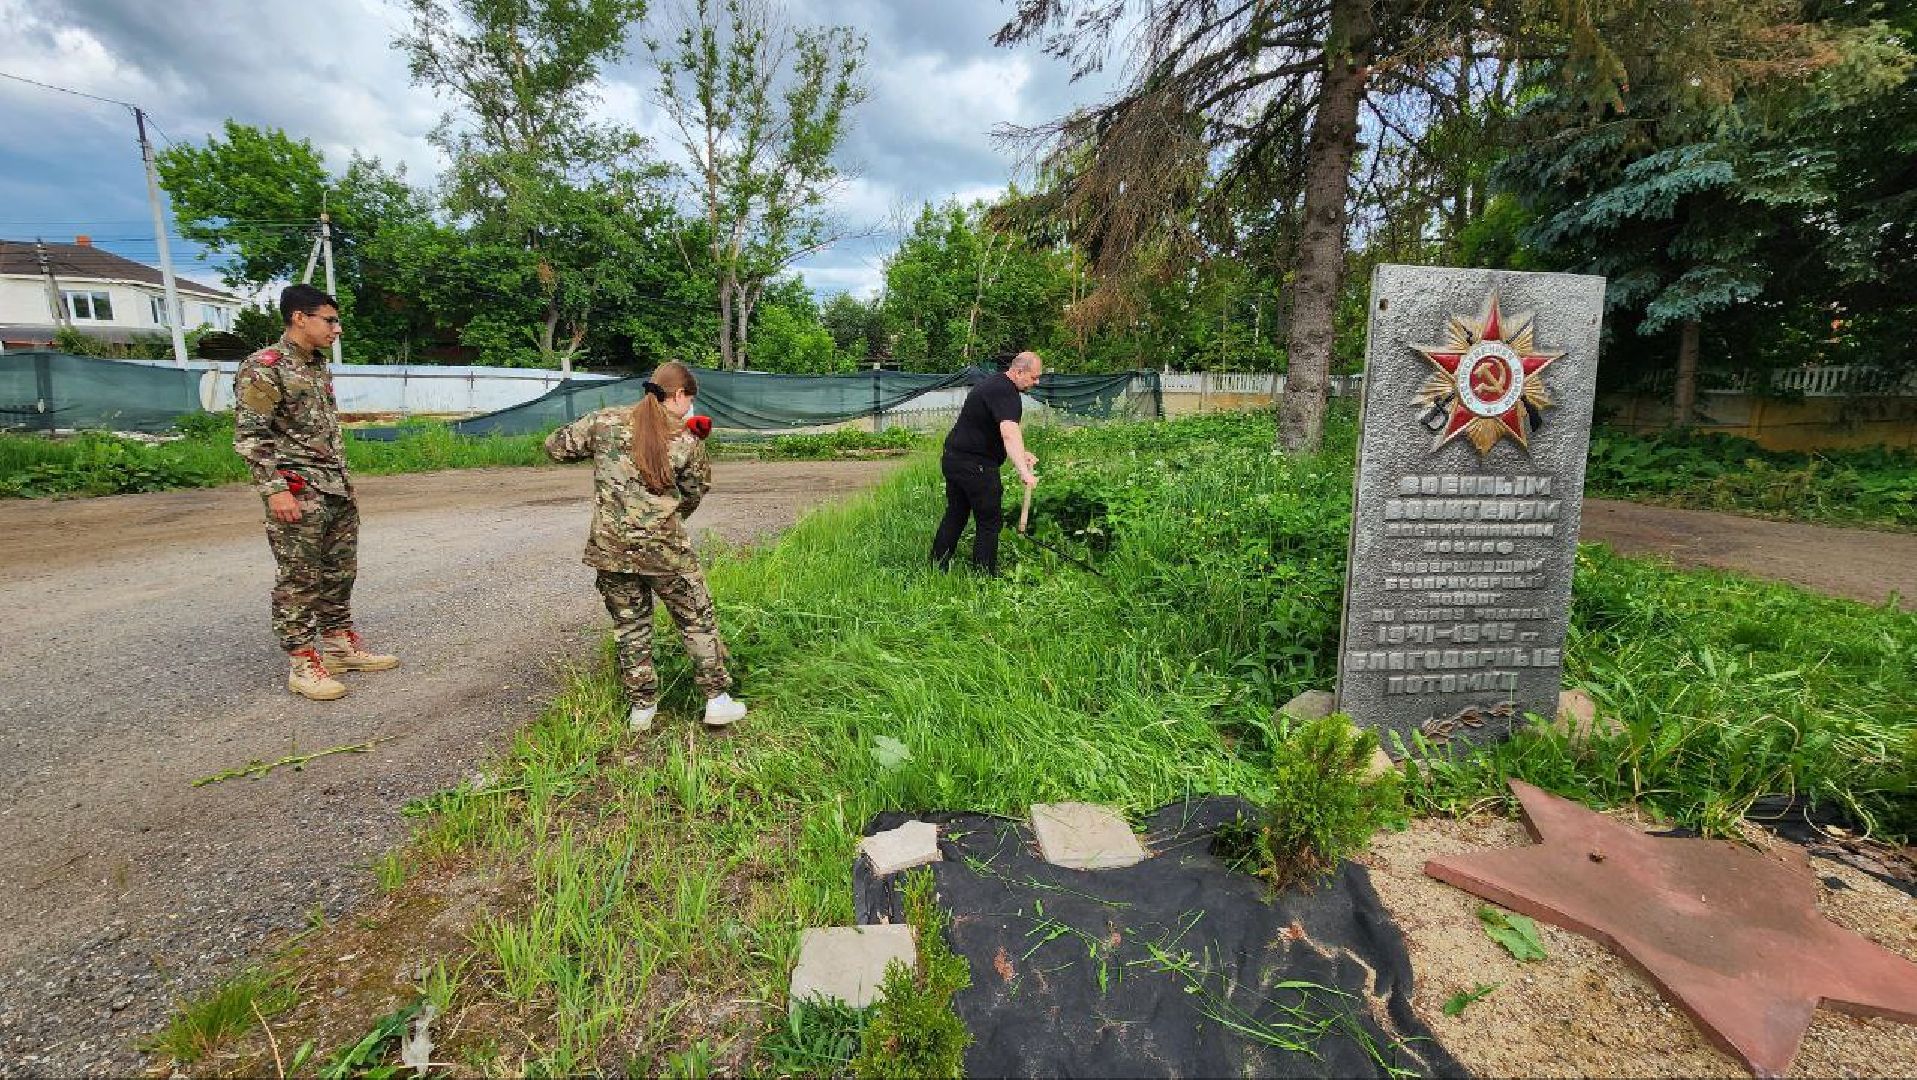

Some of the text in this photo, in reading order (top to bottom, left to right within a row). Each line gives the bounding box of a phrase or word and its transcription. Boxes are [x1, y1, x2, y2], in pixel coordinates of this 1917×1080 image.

[1400, 475, 1551, 496] ВОЕННЫМ
[1385, 500, 1560, 521] ВОДИТЕЛЯМ
[1350, 648, 1561, 670] БЛАГОДАРНЫЕ
[1388, 671, 1519, 693] ПОТОМКИ
